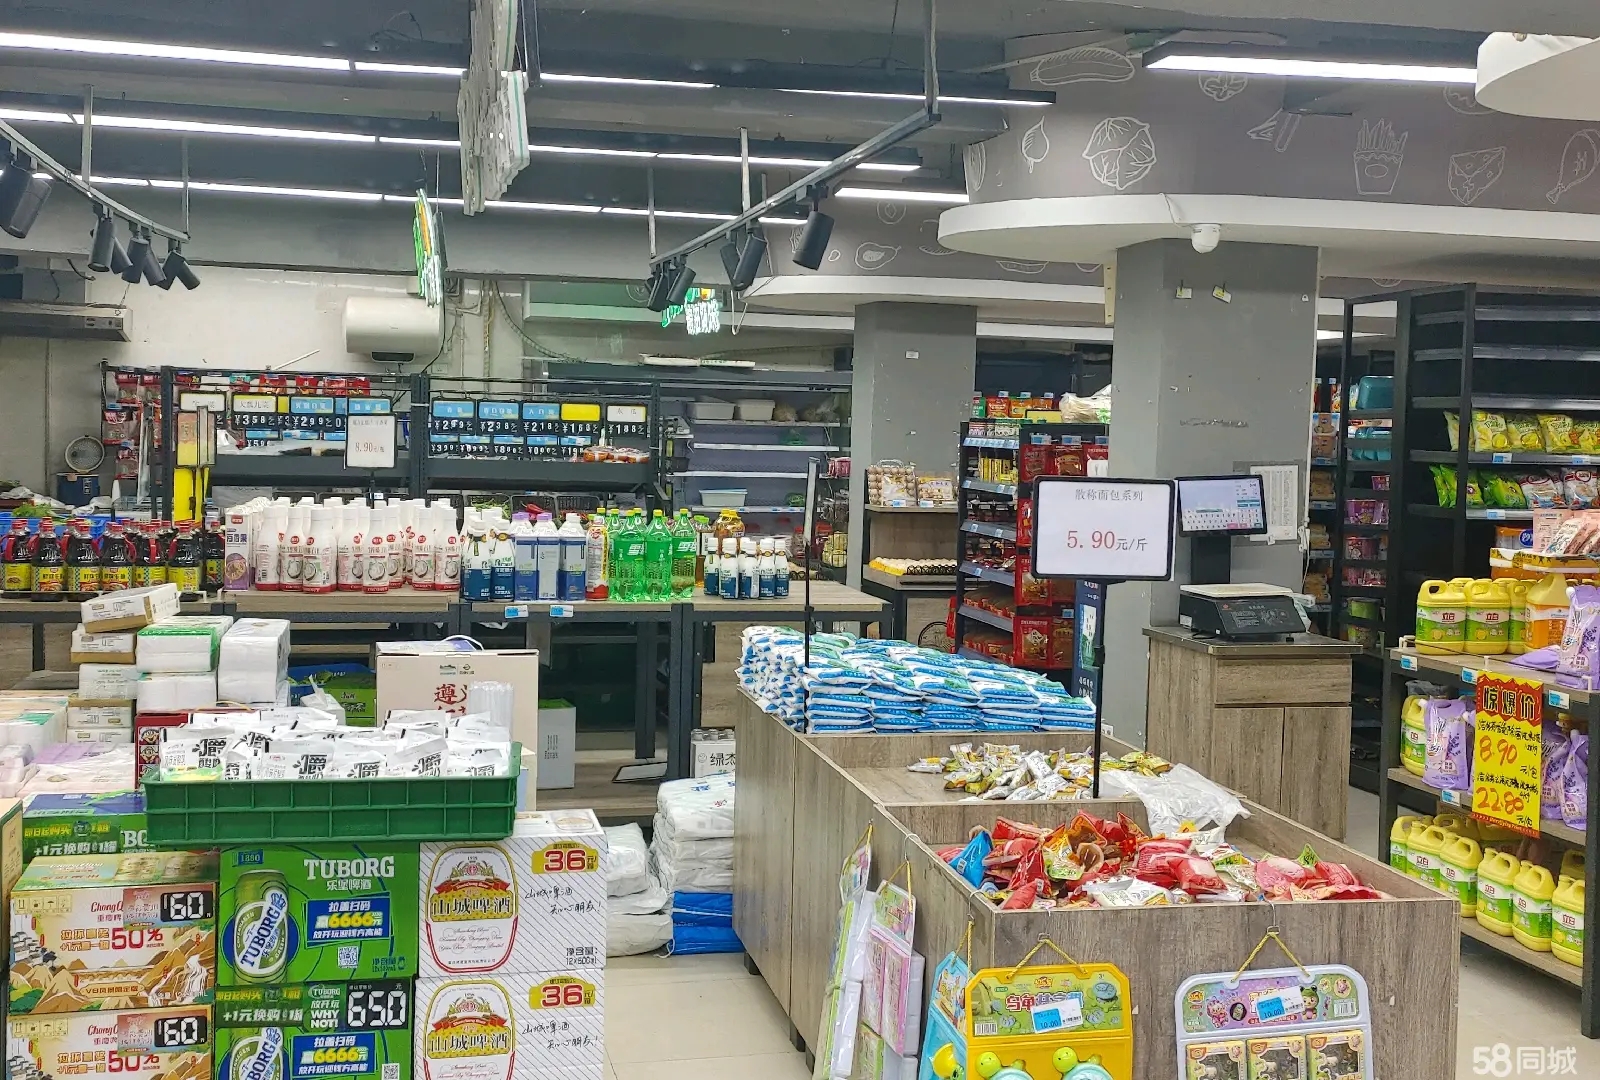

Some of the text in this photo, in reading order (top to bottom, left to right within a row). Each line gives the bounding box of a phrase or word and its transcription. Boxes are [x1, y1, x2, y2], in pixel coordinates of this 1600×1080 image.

[1074, 489, 1144, 502] 散称面包系列
[1483, 685, 1536, 721] 惊爆价
[303, 856, 395, 880] TUBORG
[544, 849, 586, 872] 36
[326, 878, 372, 891] 乐堡啤酒
[431, 896, 511, 916] 山城啤酒
[112, 927, 164, 950] 50%
[240, 905, 282, 968] TUBORG
[541, 984, 583, 1008] 36
[310, 1009, 339, 1019] WHY
[310, 1019, 339, 1029] NOT!
[431, 1032, 509, 1052] 山城啤酒
[108, 1051, 160, 1073] 50%
